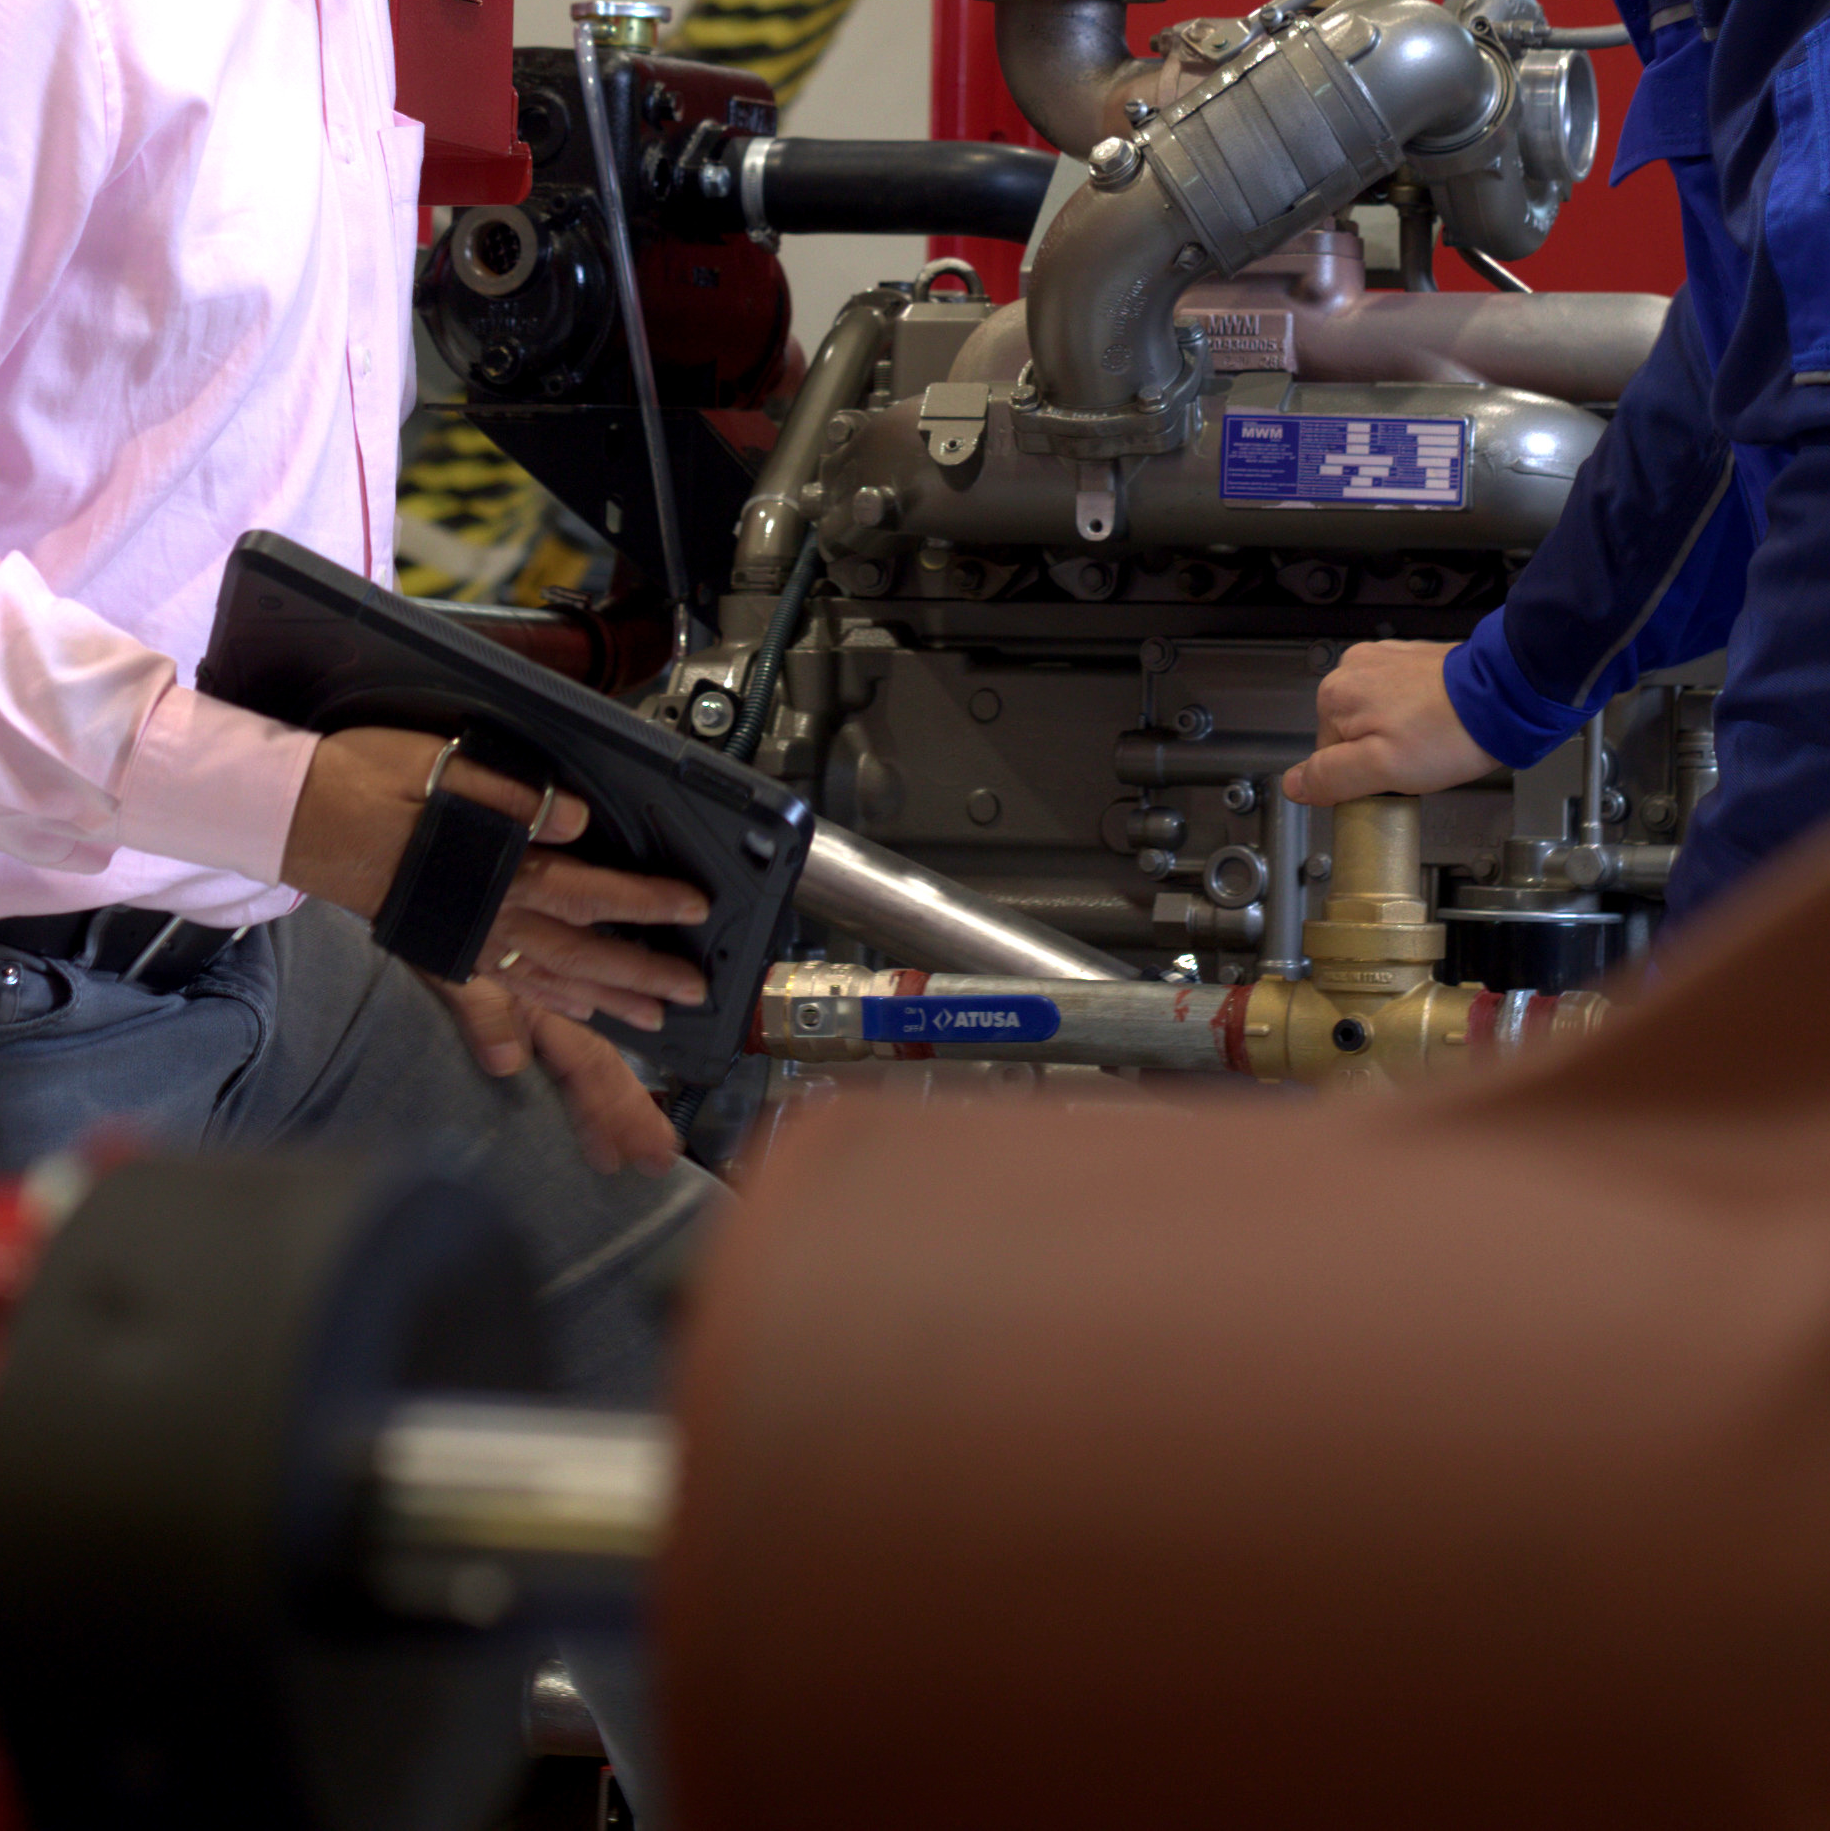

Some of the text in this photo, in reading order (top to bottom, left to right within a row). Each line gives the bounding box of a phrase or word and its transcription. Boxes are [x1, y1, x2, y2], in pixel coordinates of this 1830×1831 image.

[1207, 314, 1260, 336] MWM
[1241, 427, 1283, 440] MWM
[954, 1011, 1021, 1028] ATUSA
